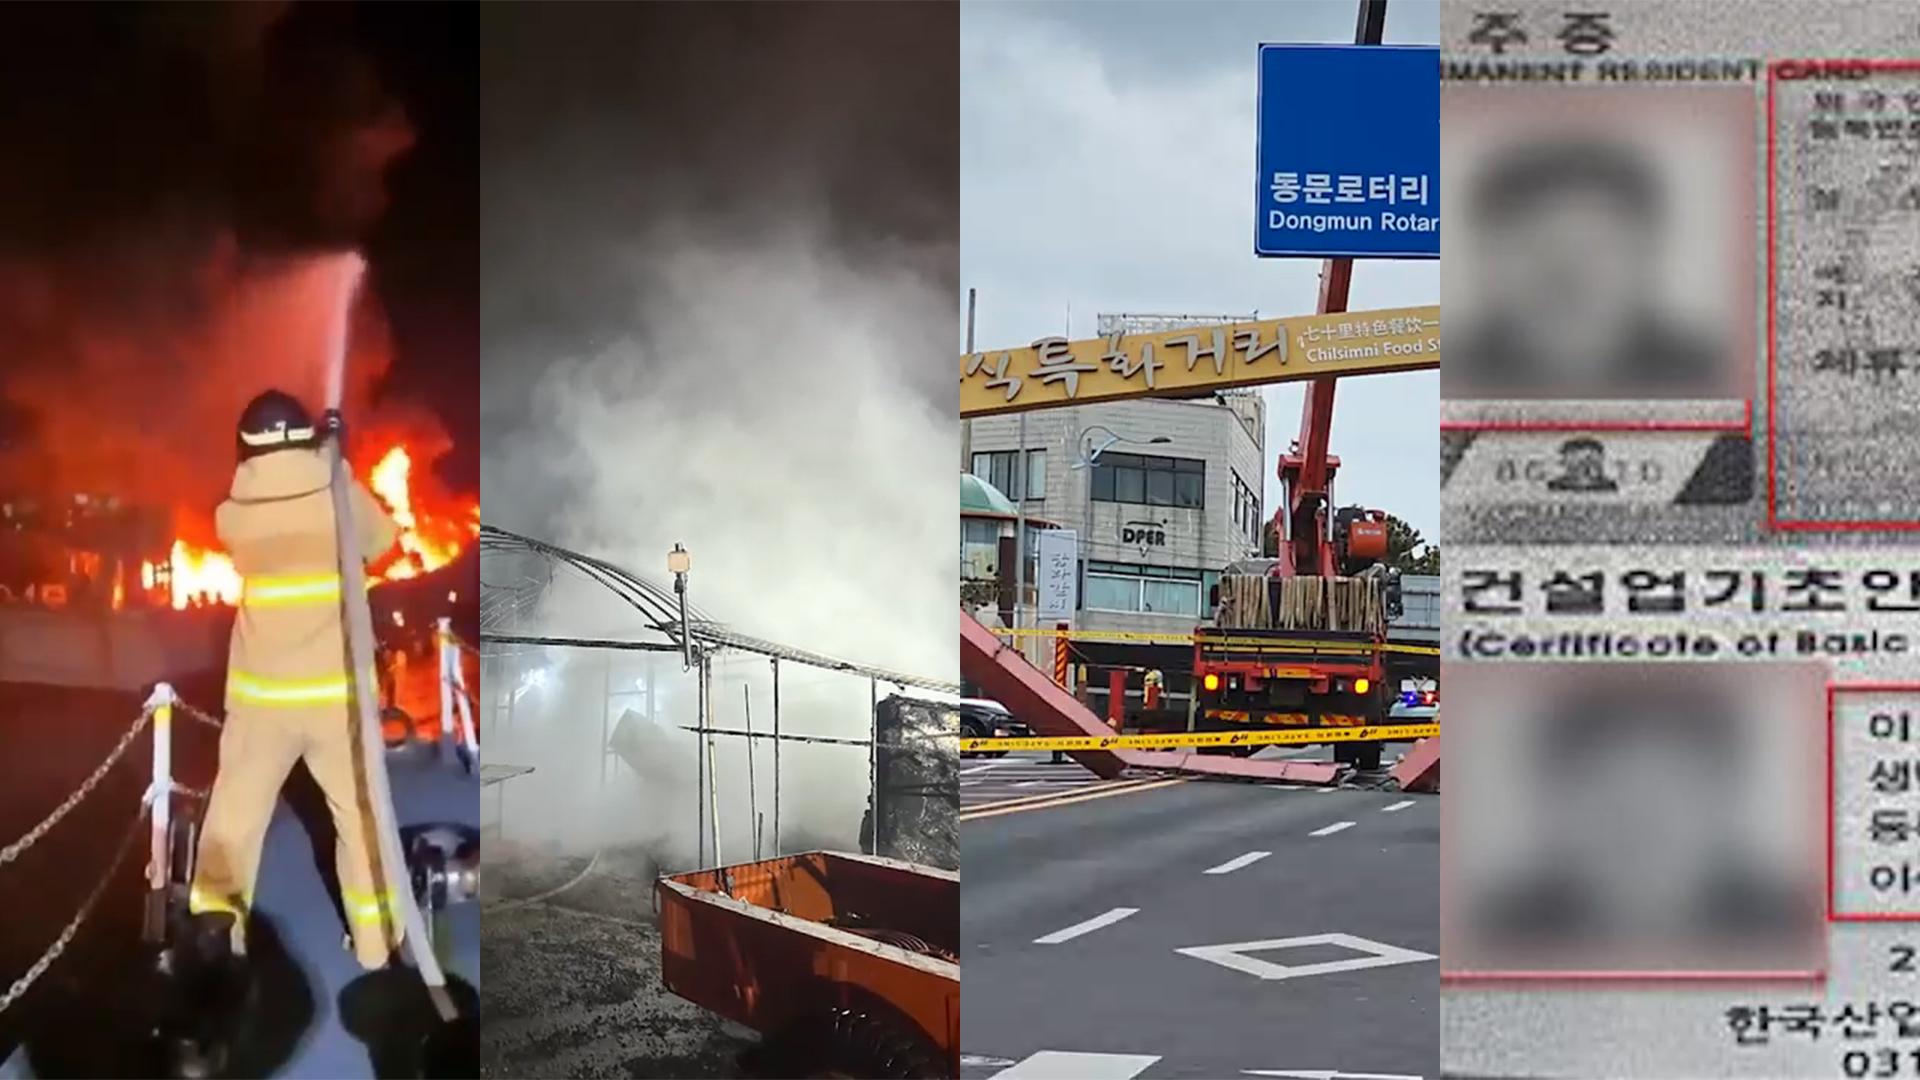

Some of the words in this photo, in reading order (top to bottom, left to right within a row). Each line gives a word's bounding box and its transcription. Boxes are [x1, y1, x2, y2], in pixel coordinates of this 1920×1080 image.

[1440, 60, 1582, 81] MANENT
[1270, 172, 1428, 206] 동문로터리
[1269, 210, 1372, 232] Dongmun
[960, 324, 1287, 402] 식특화거리
[1306, 341, 1380, 364] Chilsimni
[1383, 338, 1423, 356] Food
[1737, 632, 1779, 657] of
[1796, 629, 1909, 656] Basic
